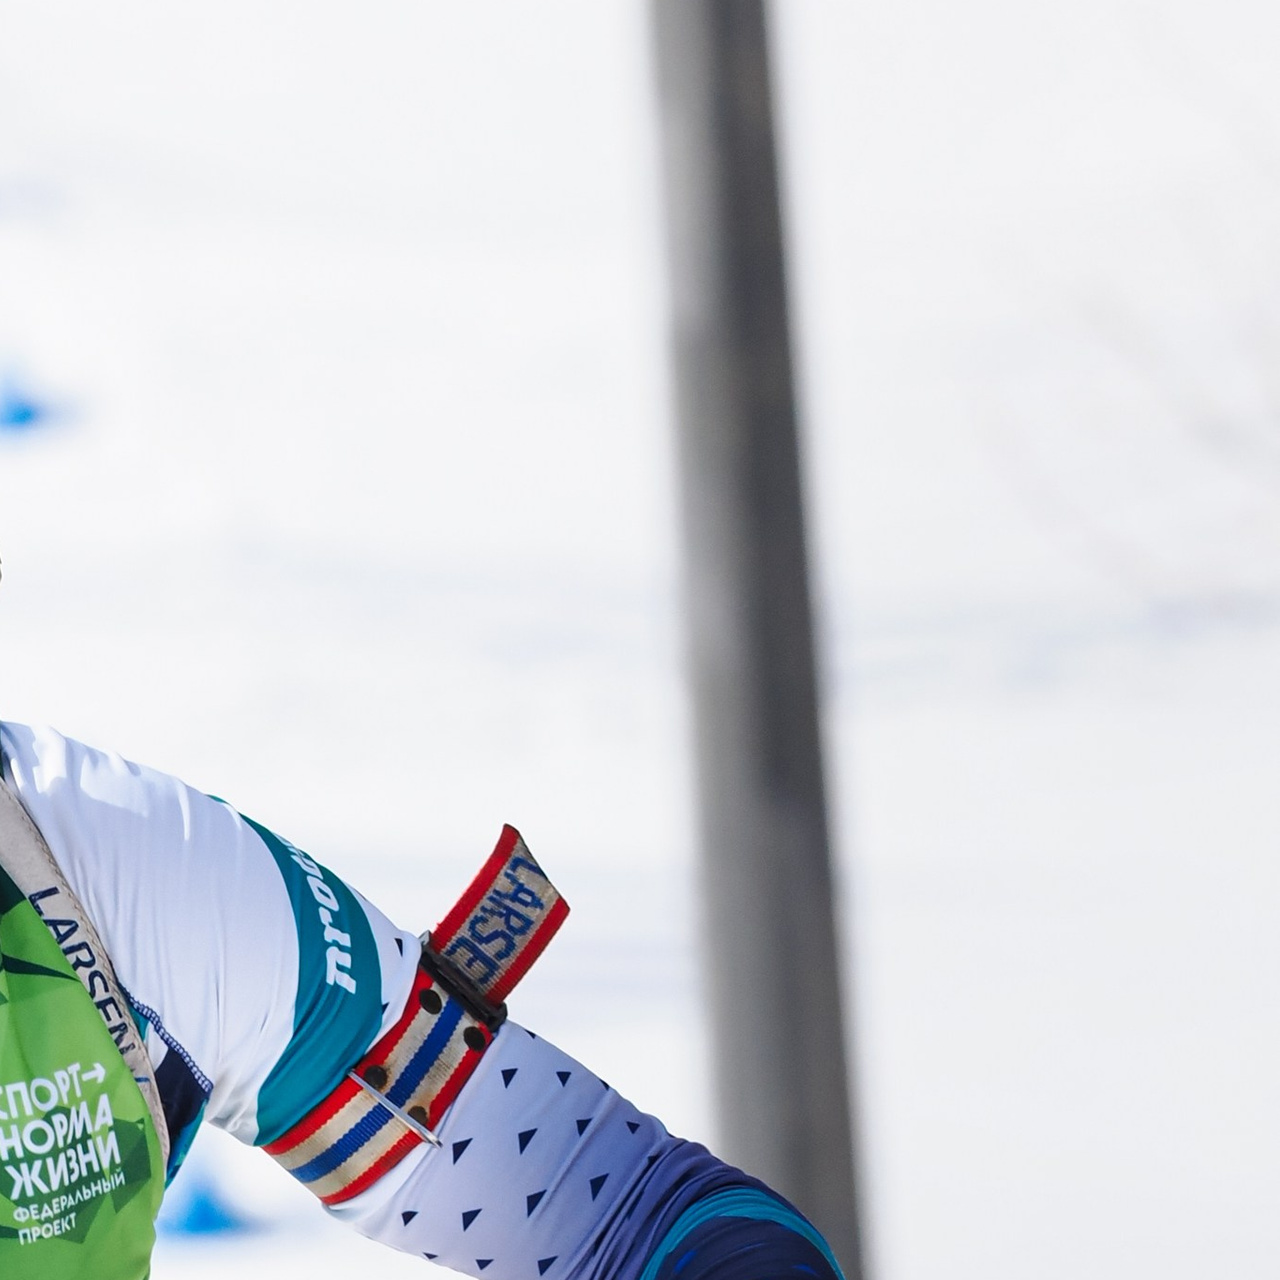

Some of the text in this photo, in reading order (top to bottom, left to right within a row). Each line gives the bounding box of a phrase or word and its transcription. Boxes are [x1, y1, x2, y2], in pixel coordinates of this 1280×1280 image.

[444, 855, 548, 986] LARSE
[28, 886, 136, 1056] LARSEN
[4, 1131, 122, 1201] ЖИЗНИ
[13, 1166, 126, 1223] ФЕДЕРАЛЬНЫЙ
[18, 1212, 78, 1246] ПРОЕКТ
